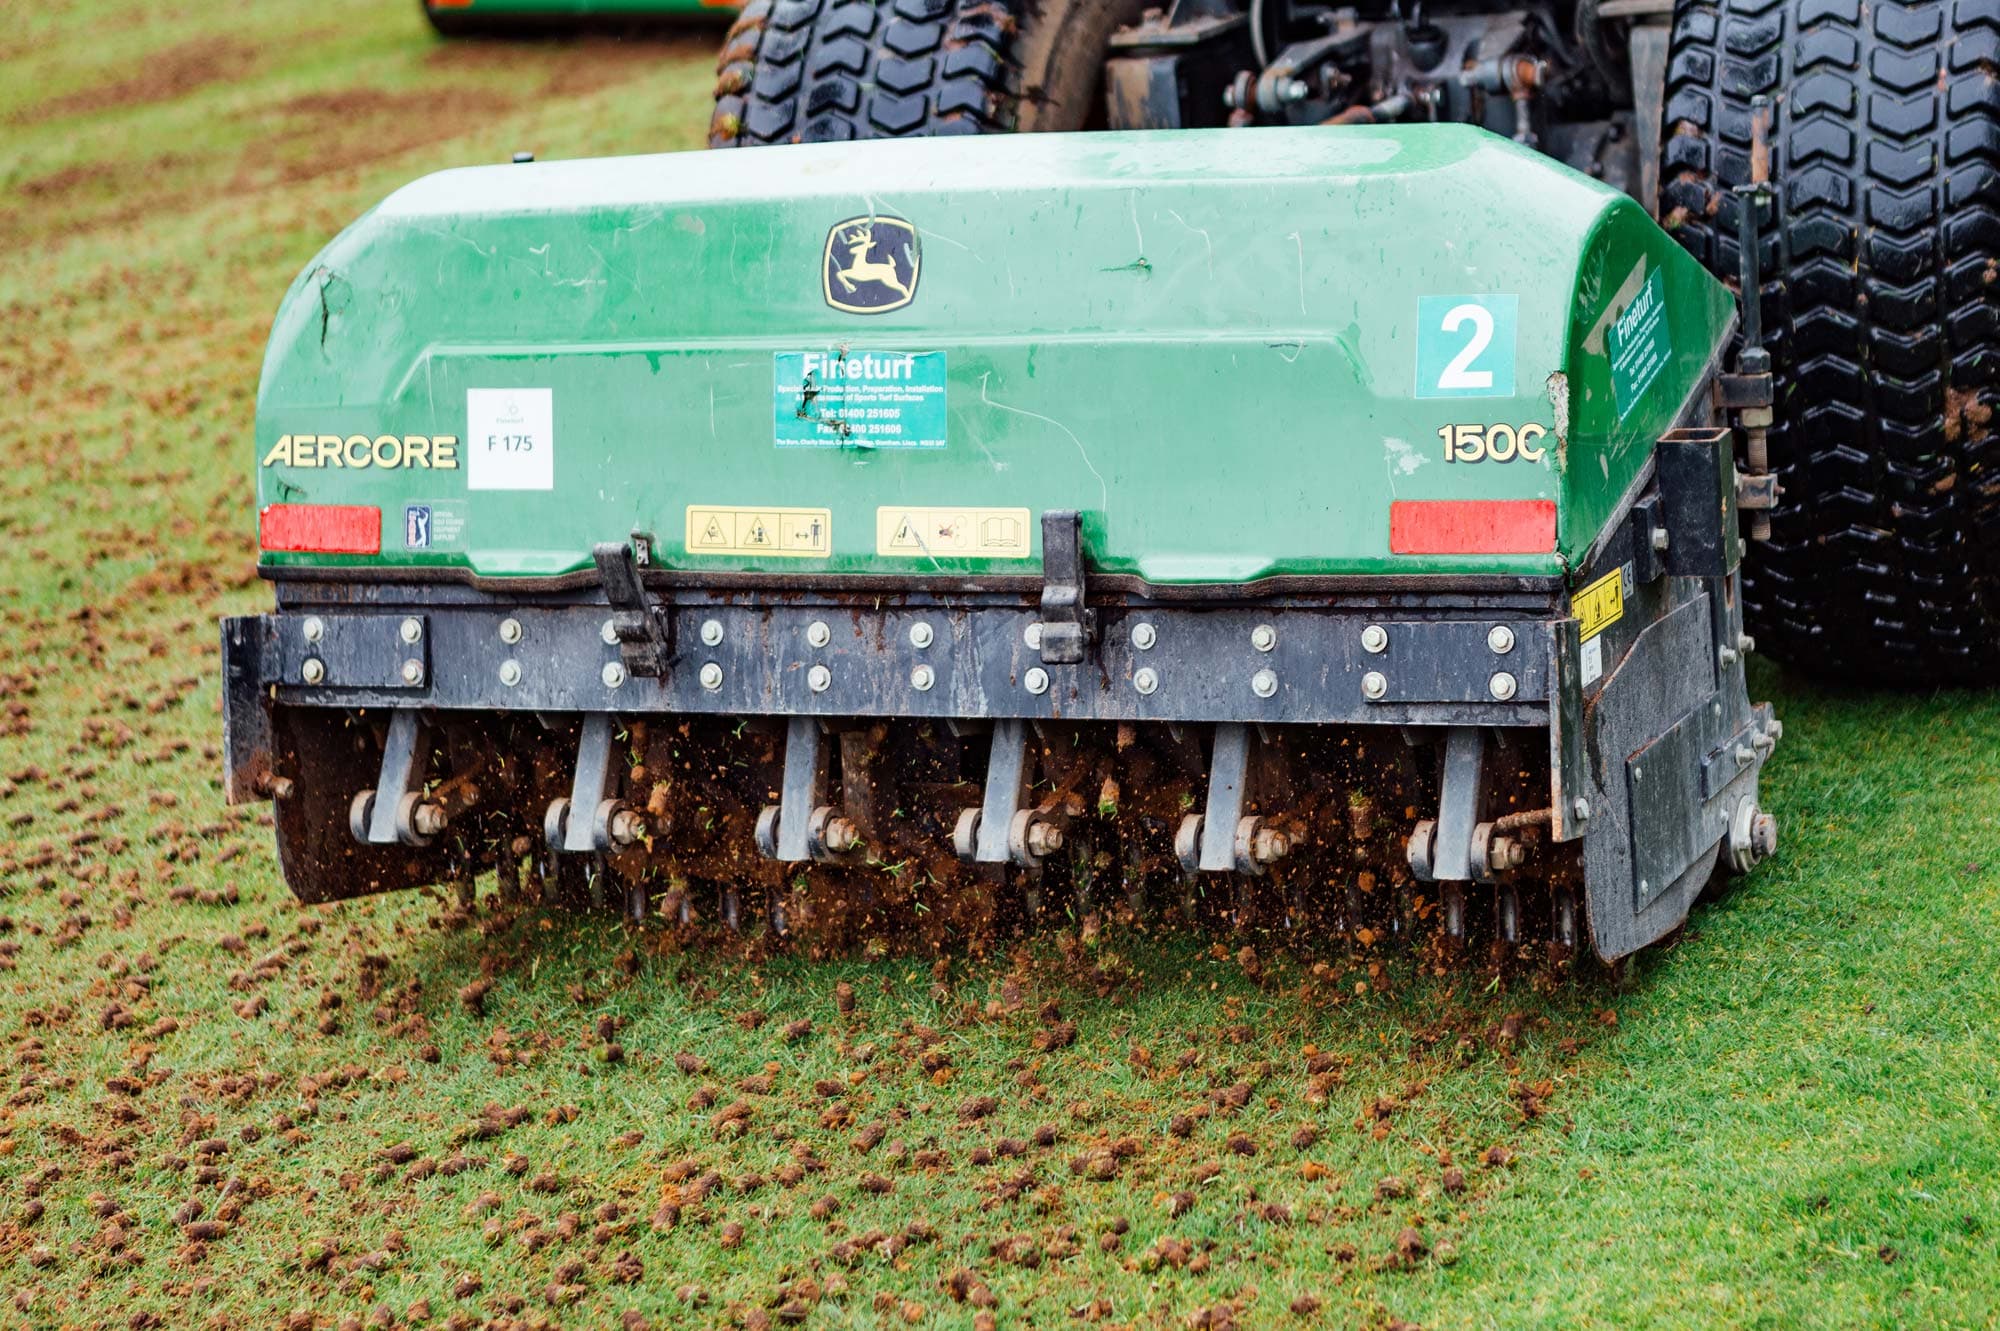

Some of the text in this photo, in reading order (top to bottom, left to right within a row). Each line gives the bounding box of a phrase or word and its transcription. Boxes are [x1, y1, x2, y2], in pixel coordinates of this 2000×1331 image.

[1617, 279, 1654, 347] Fineturf
[1437, 303, 1495, 390] 2
[802, 353, 914, 380] Fineturf
[821, 409, 836, 418] Tel:
[263, 434, 460, 470] AERCORE
[488, 434, 533, 452] F 175
[1438, 422, 1547, 464] 150C
